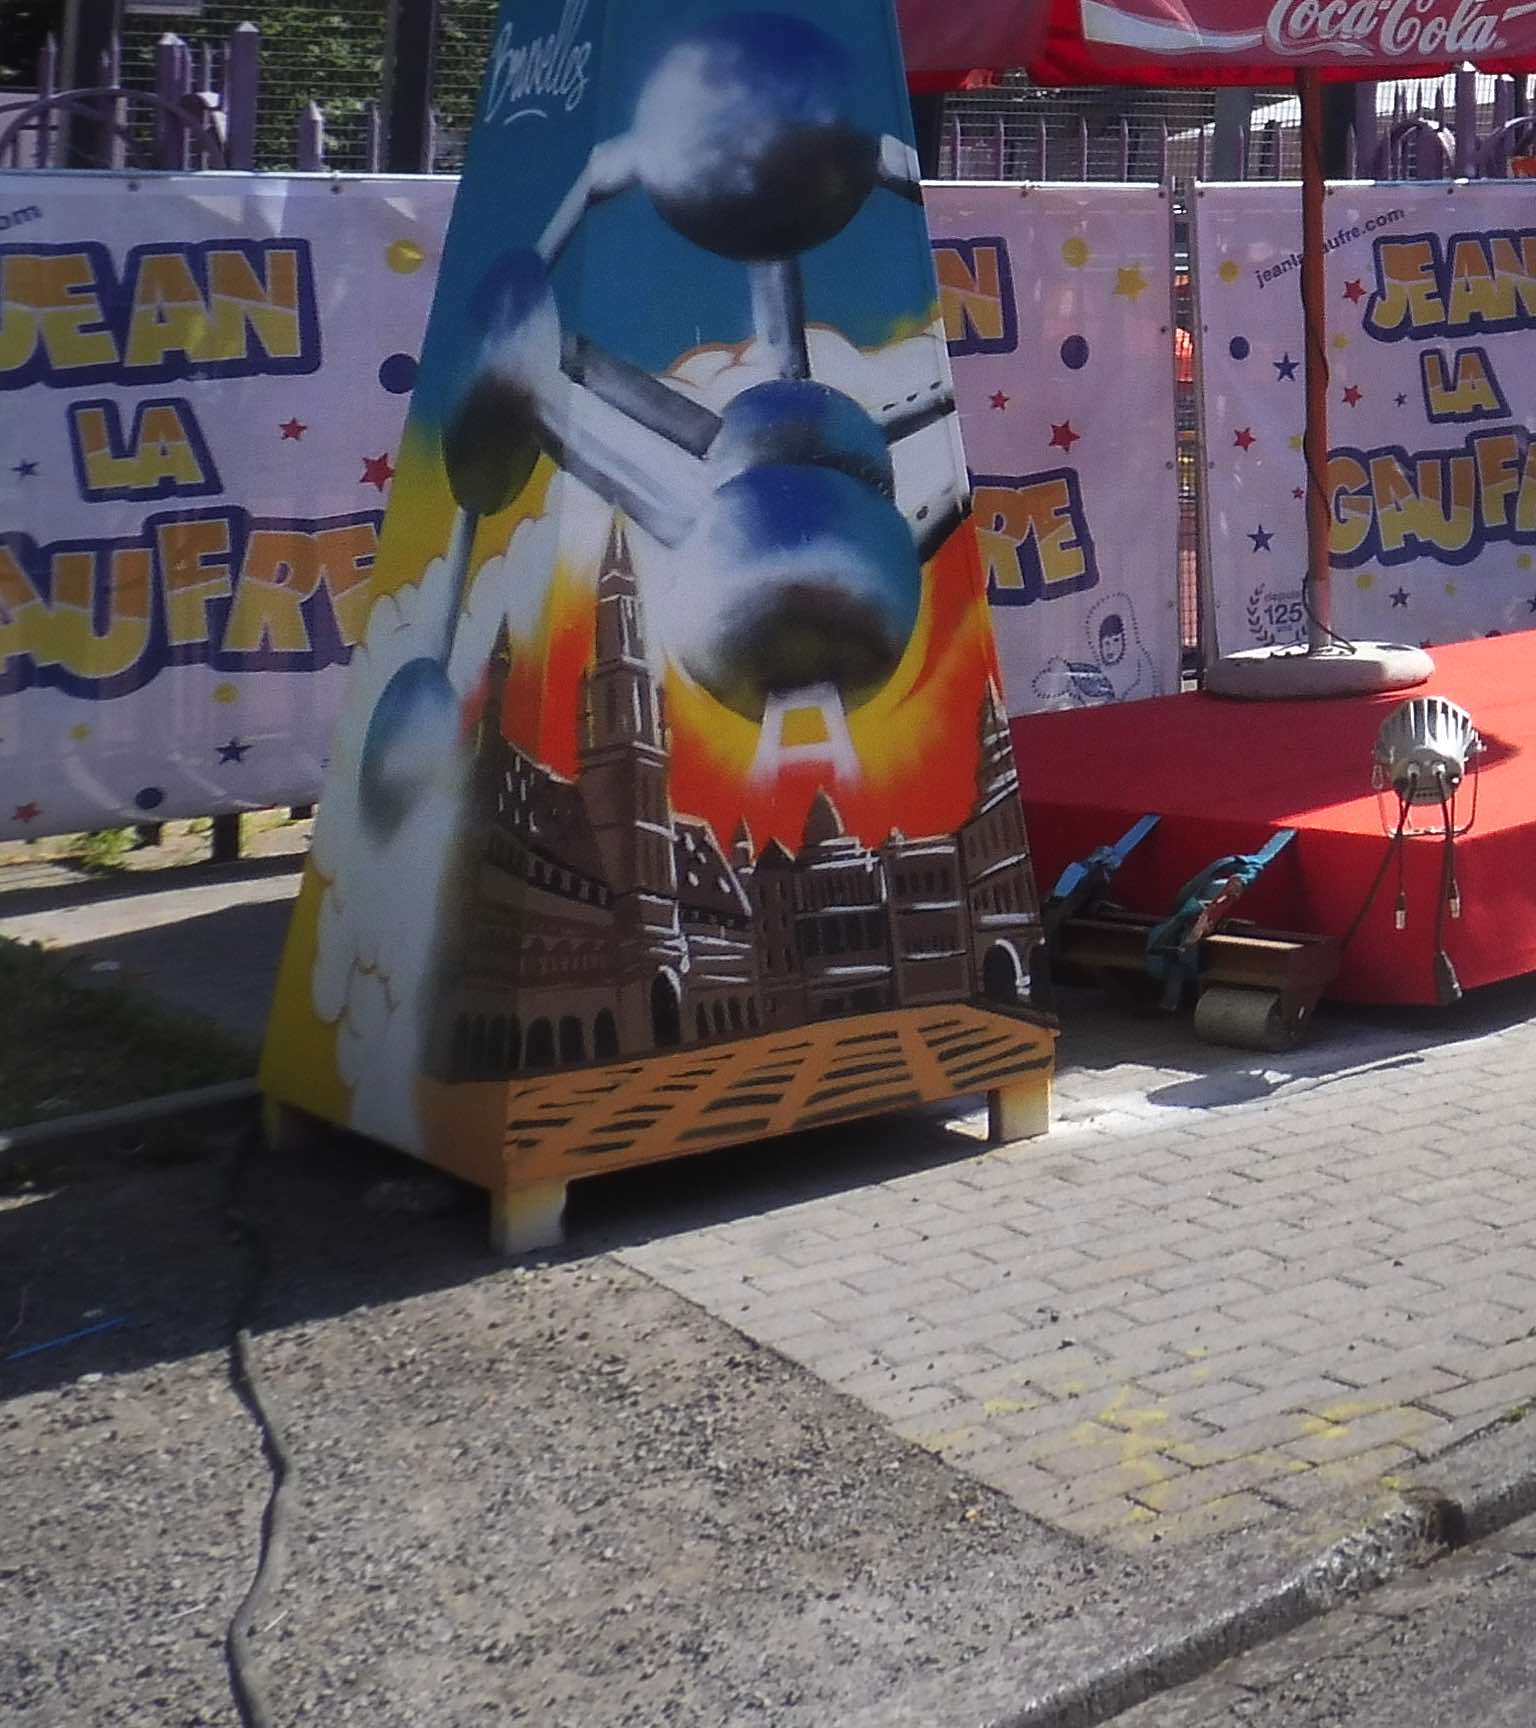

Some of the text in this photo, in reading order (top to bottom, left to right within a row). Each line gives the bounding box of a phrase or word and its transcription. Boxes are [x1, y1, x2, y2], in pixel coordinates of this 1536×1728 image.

[1422, 350, 1507, 419] LA
[72, 402, 215, 496] LA
[1264, 602, 1302, 625] 125
